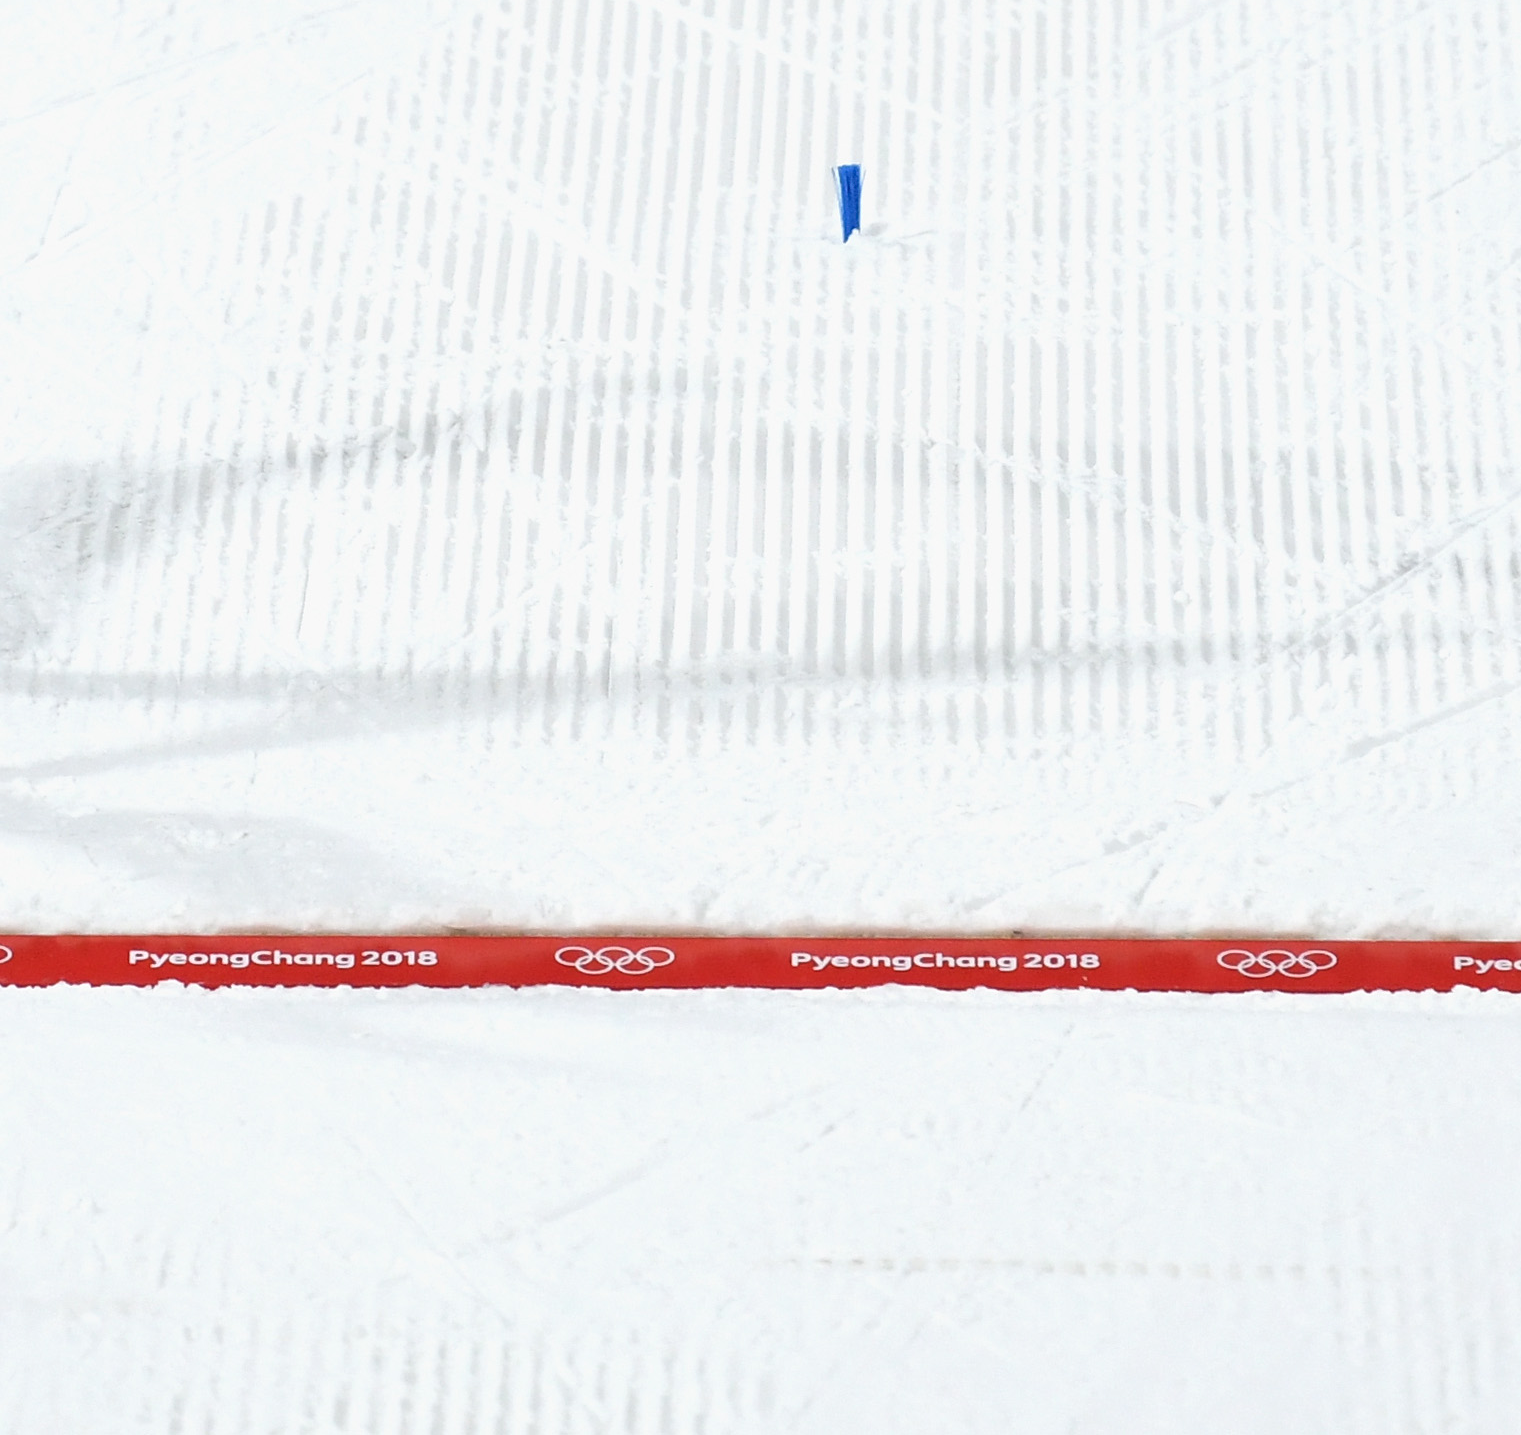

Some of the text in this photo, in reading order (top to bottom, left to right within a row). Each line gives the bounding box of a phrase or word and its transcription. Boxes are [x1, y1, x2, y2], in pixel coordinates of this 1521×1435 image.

[128, 949, 438, 969] PyeongChang 2018
[790, 952, 1101, 972] PyeongChang 2018
